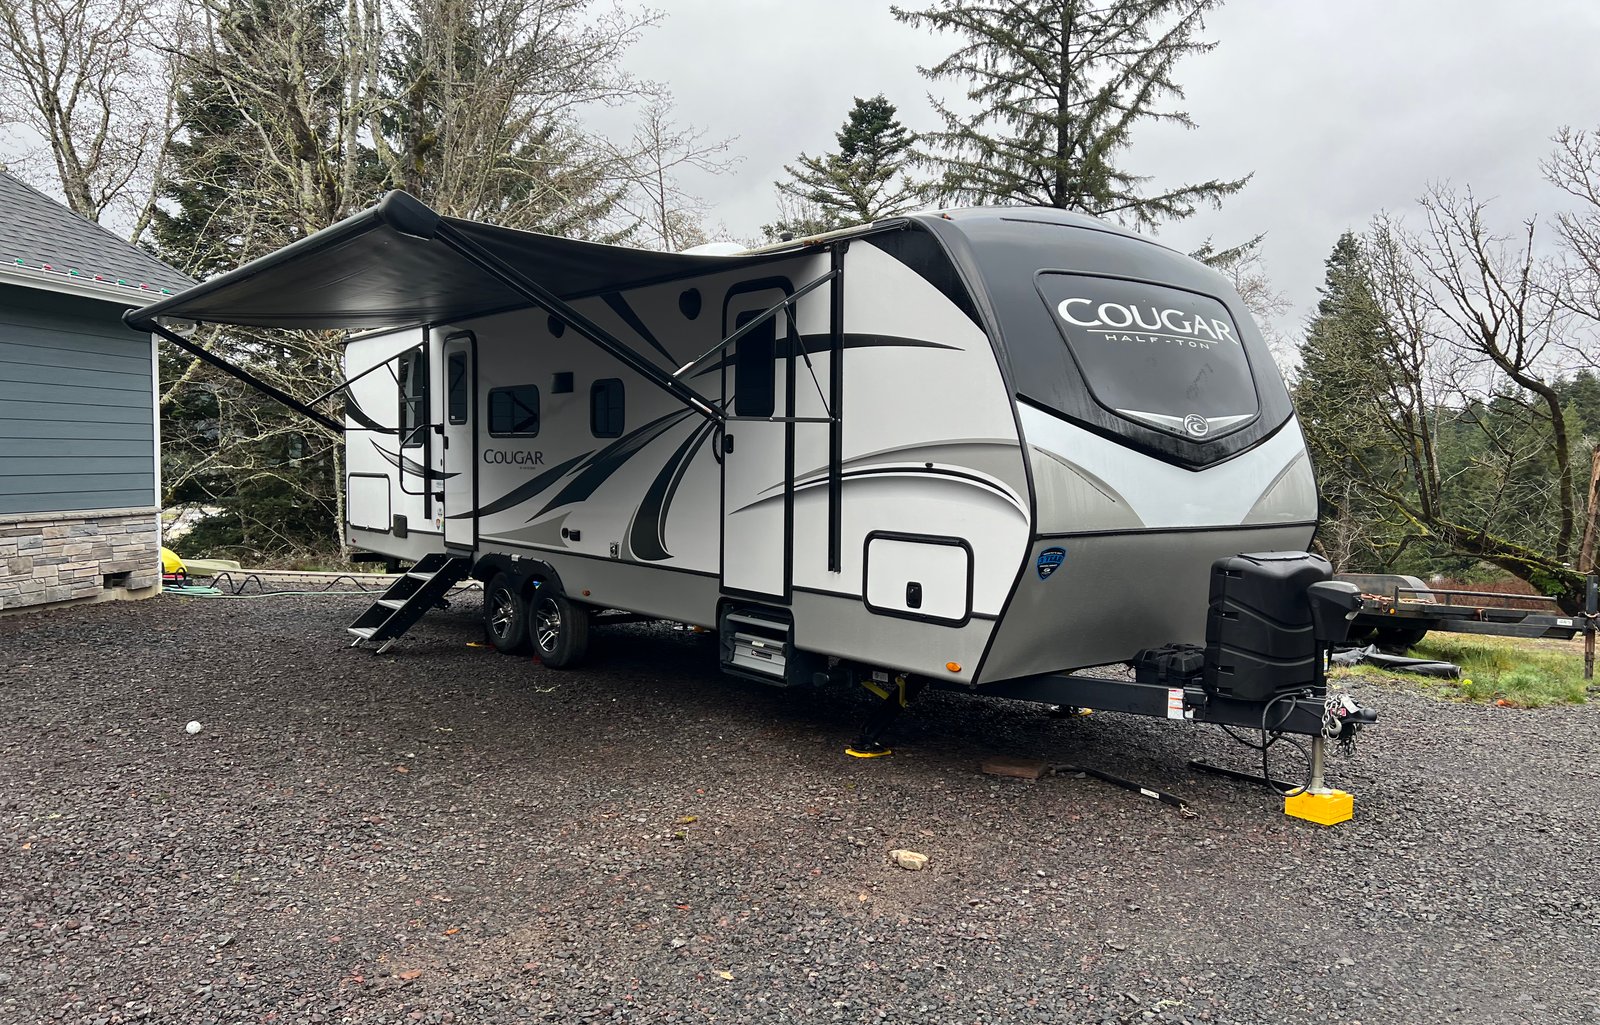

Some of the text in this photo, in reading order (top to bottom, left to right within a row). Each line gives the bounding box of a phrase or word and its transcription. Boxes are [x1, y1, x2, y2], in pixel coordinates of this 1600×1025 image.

[1057, 298, 1239, 345] COUGAR
[1105, 334, 1210, 350] HALF-TON
[483, 448, 544, 465] COUGAR
